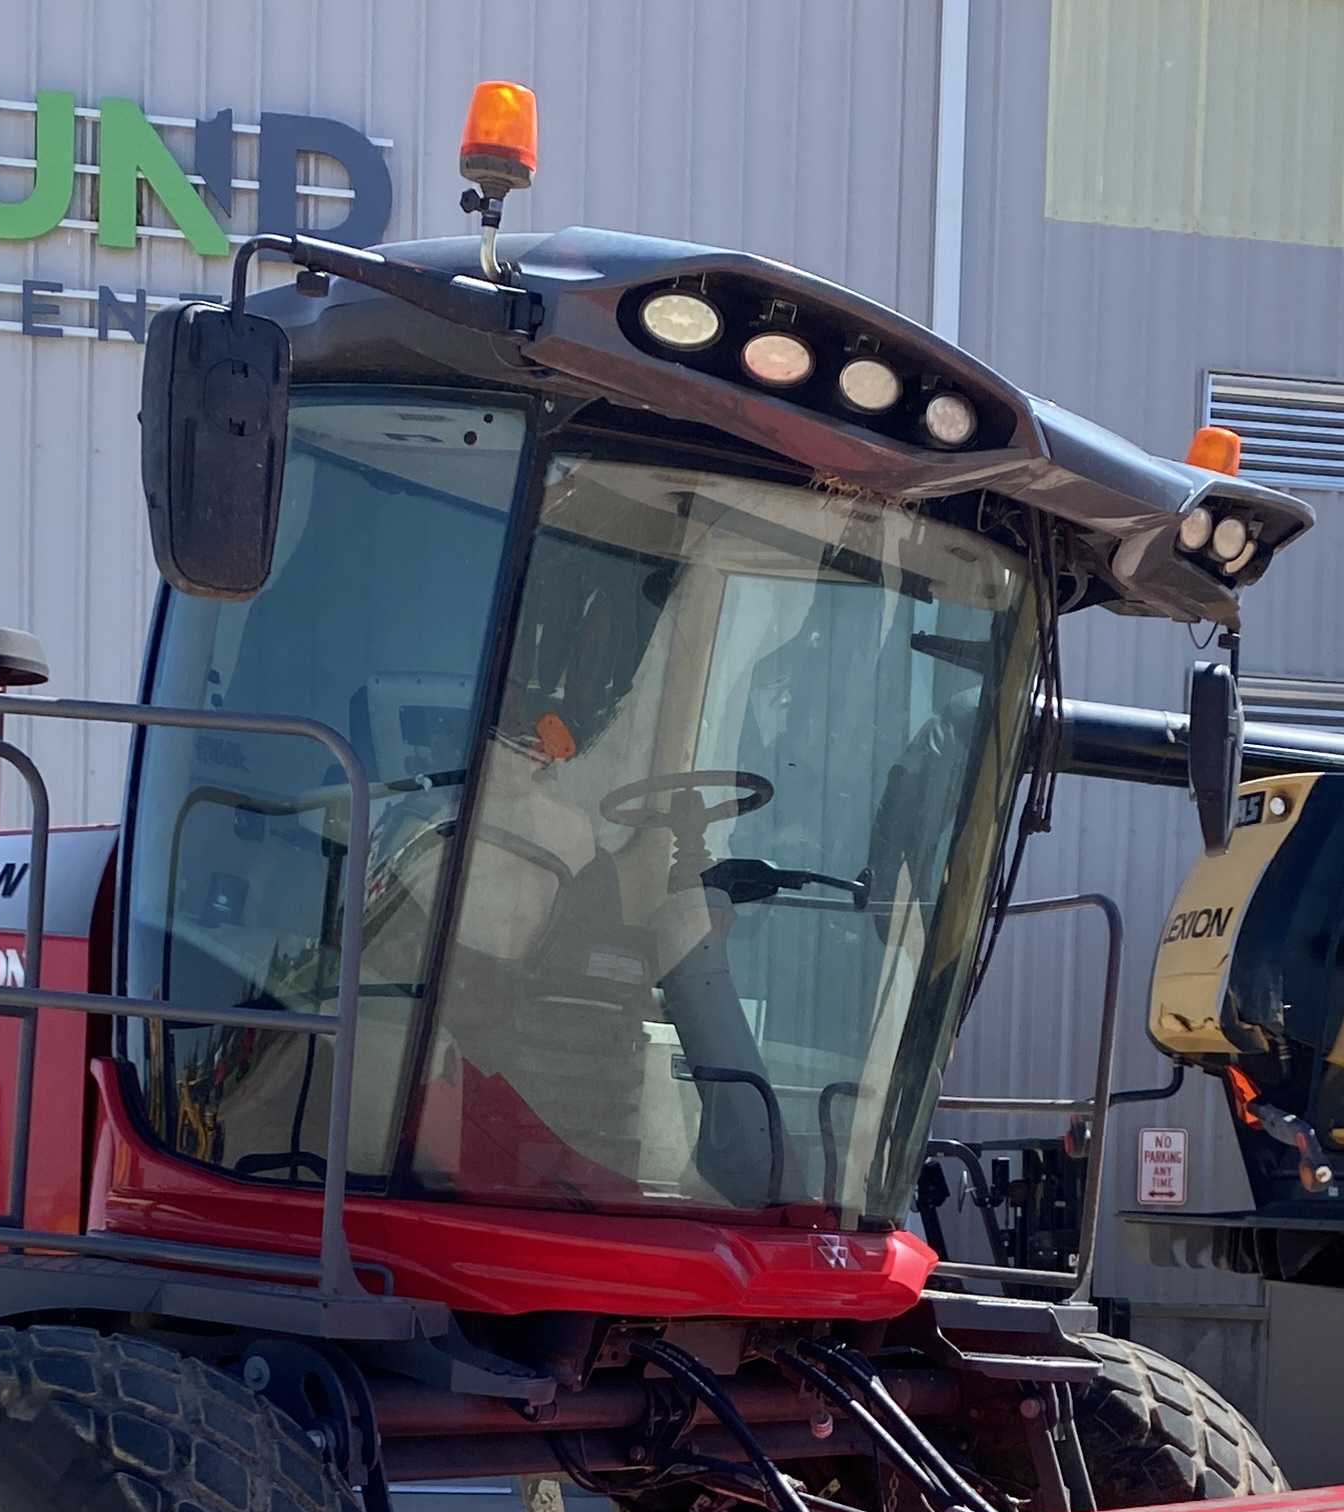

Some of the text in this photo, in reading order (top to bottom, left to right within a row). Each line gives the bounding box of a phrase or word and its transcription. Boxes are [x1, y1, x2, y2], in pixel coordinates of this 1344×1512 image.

[1155, 1135, 1172, 1149] NO
[1144, 1150, 1183, 1164] PARKING
[1153, 1166, 1173, 1177] ANY
[1152, 1177, 1174, 1188] TIME
